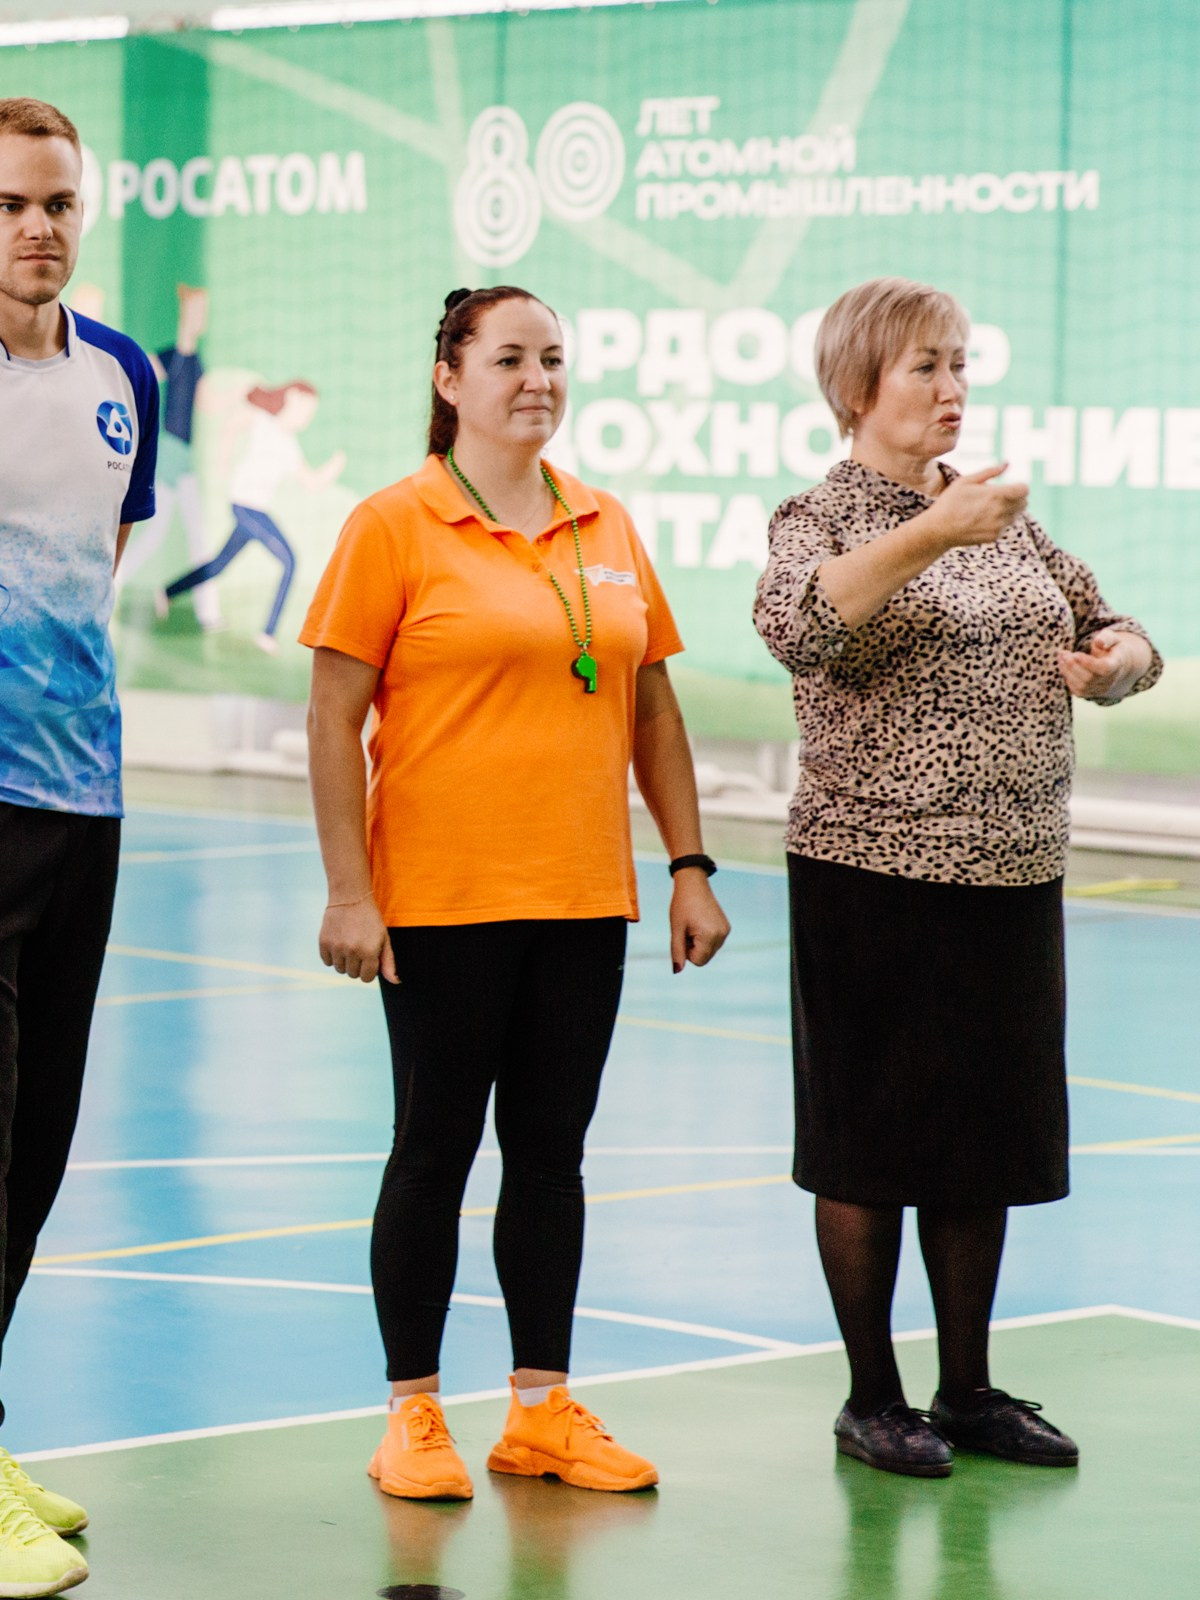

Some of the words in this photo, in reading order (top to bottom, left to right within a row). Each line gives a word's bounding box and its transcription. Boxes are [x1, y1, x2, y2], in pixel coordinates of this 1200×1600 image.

[635, 95, 721, 137] ЛЕТ
[634, 124, 856, 179] АТОМНОЙ
[108, 152, 366, 219] РОСАТОМ
[453, 101, 626, 268] 80
[636, 171, 1099, 220] ПРОМЫШЛЕННОСТИ
